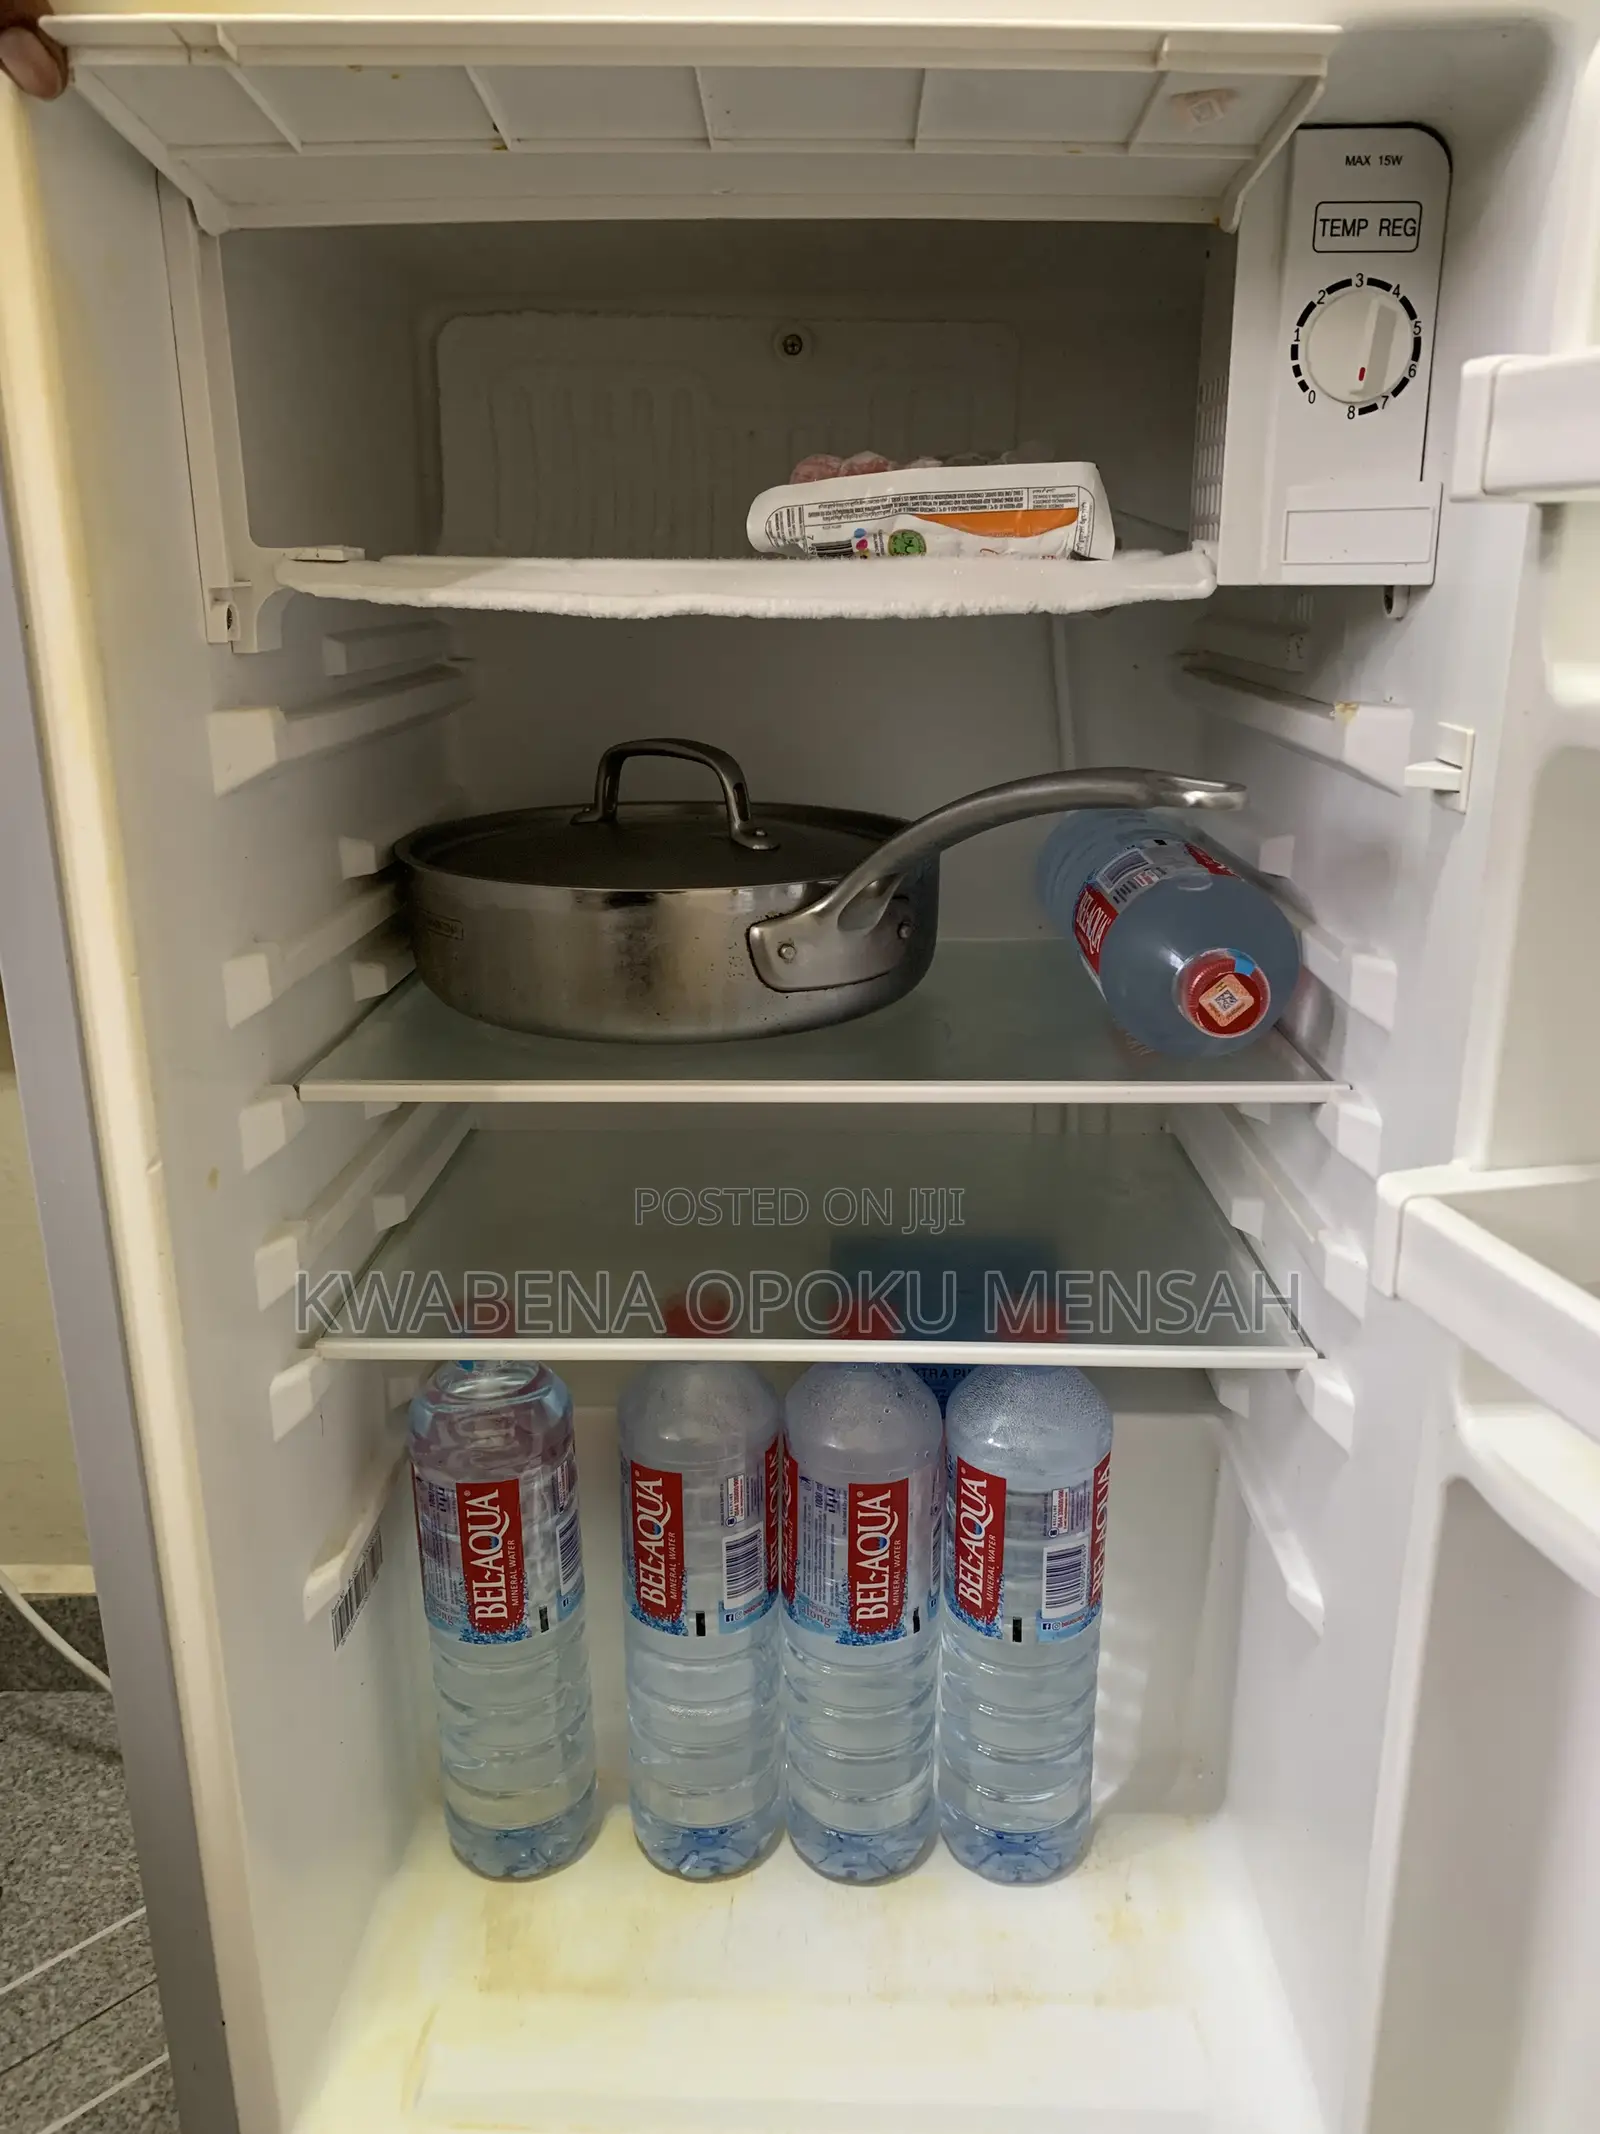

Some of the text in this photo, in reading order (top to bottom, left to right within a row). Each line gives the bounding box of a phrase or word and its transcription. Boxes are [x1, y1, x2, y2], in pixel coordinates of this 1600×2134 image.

[1345, 155, 1403, 166] MAX 15W
[1319, 218, 1417, 237] TEMP REG
[1355, 273, 1364, 288] 3
[1317, 289, 1326, 304] 2
[1392, 284, 1400, 298] 4
[1294, 328, 1300, 342] 1
[1413, 321, 1421, 335] 5
[1408, 364, 1416, 378] 6
[1308, 390, 1316, 404] 0
[1381, 395, 1389, 409] 7
[1347, 405, 1355, 420] 8
[815, 1491, 823, 1508] 1000
[986, 1534, 996, 1603] MINERAL WATER
[511, 1569, 519, 1606] MINERAL
[669, 1560, 678, 1600] MINERAL
[801, 1604, 832, 1628] along
